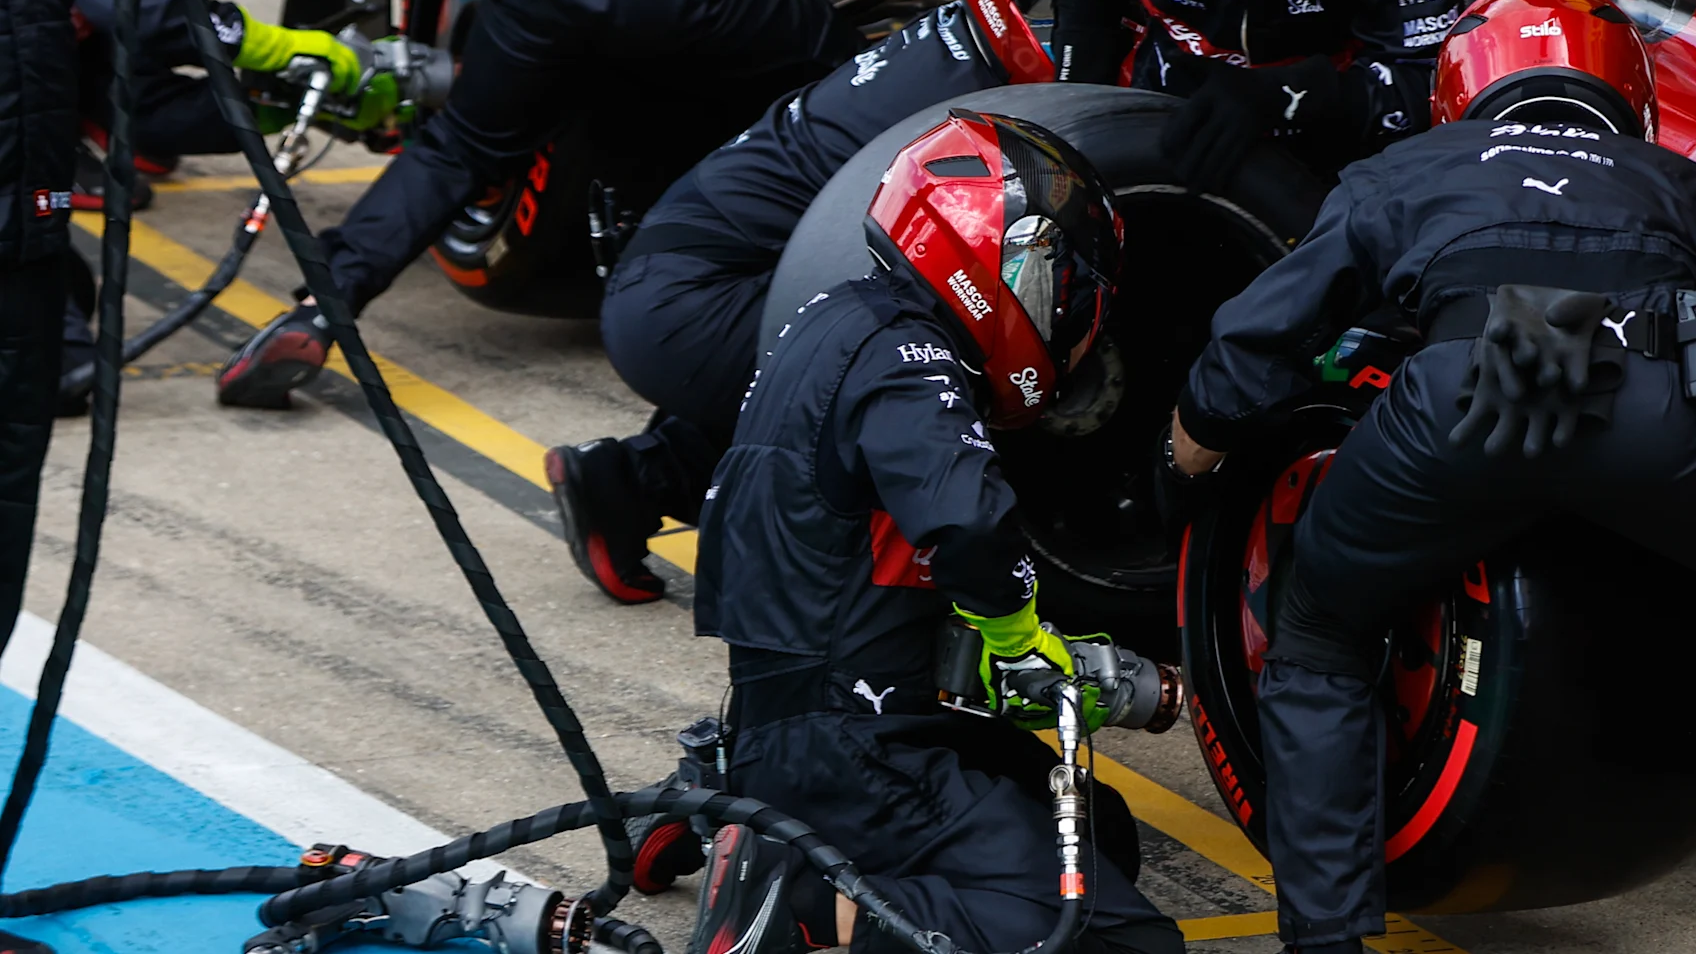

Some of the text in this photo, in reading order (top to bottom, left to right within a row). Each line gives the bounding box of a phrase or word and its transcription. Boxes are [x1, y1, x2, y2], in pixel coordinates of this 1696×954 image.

[1520, 17, 1562, 38] Stilo
[1062, 45, 1073, 67] CREW
[946, 276, 984, 321] WORKWEAR
[953, 269, 993, 315] MASCOT
[1008, 367, 1043, 407] Stake
